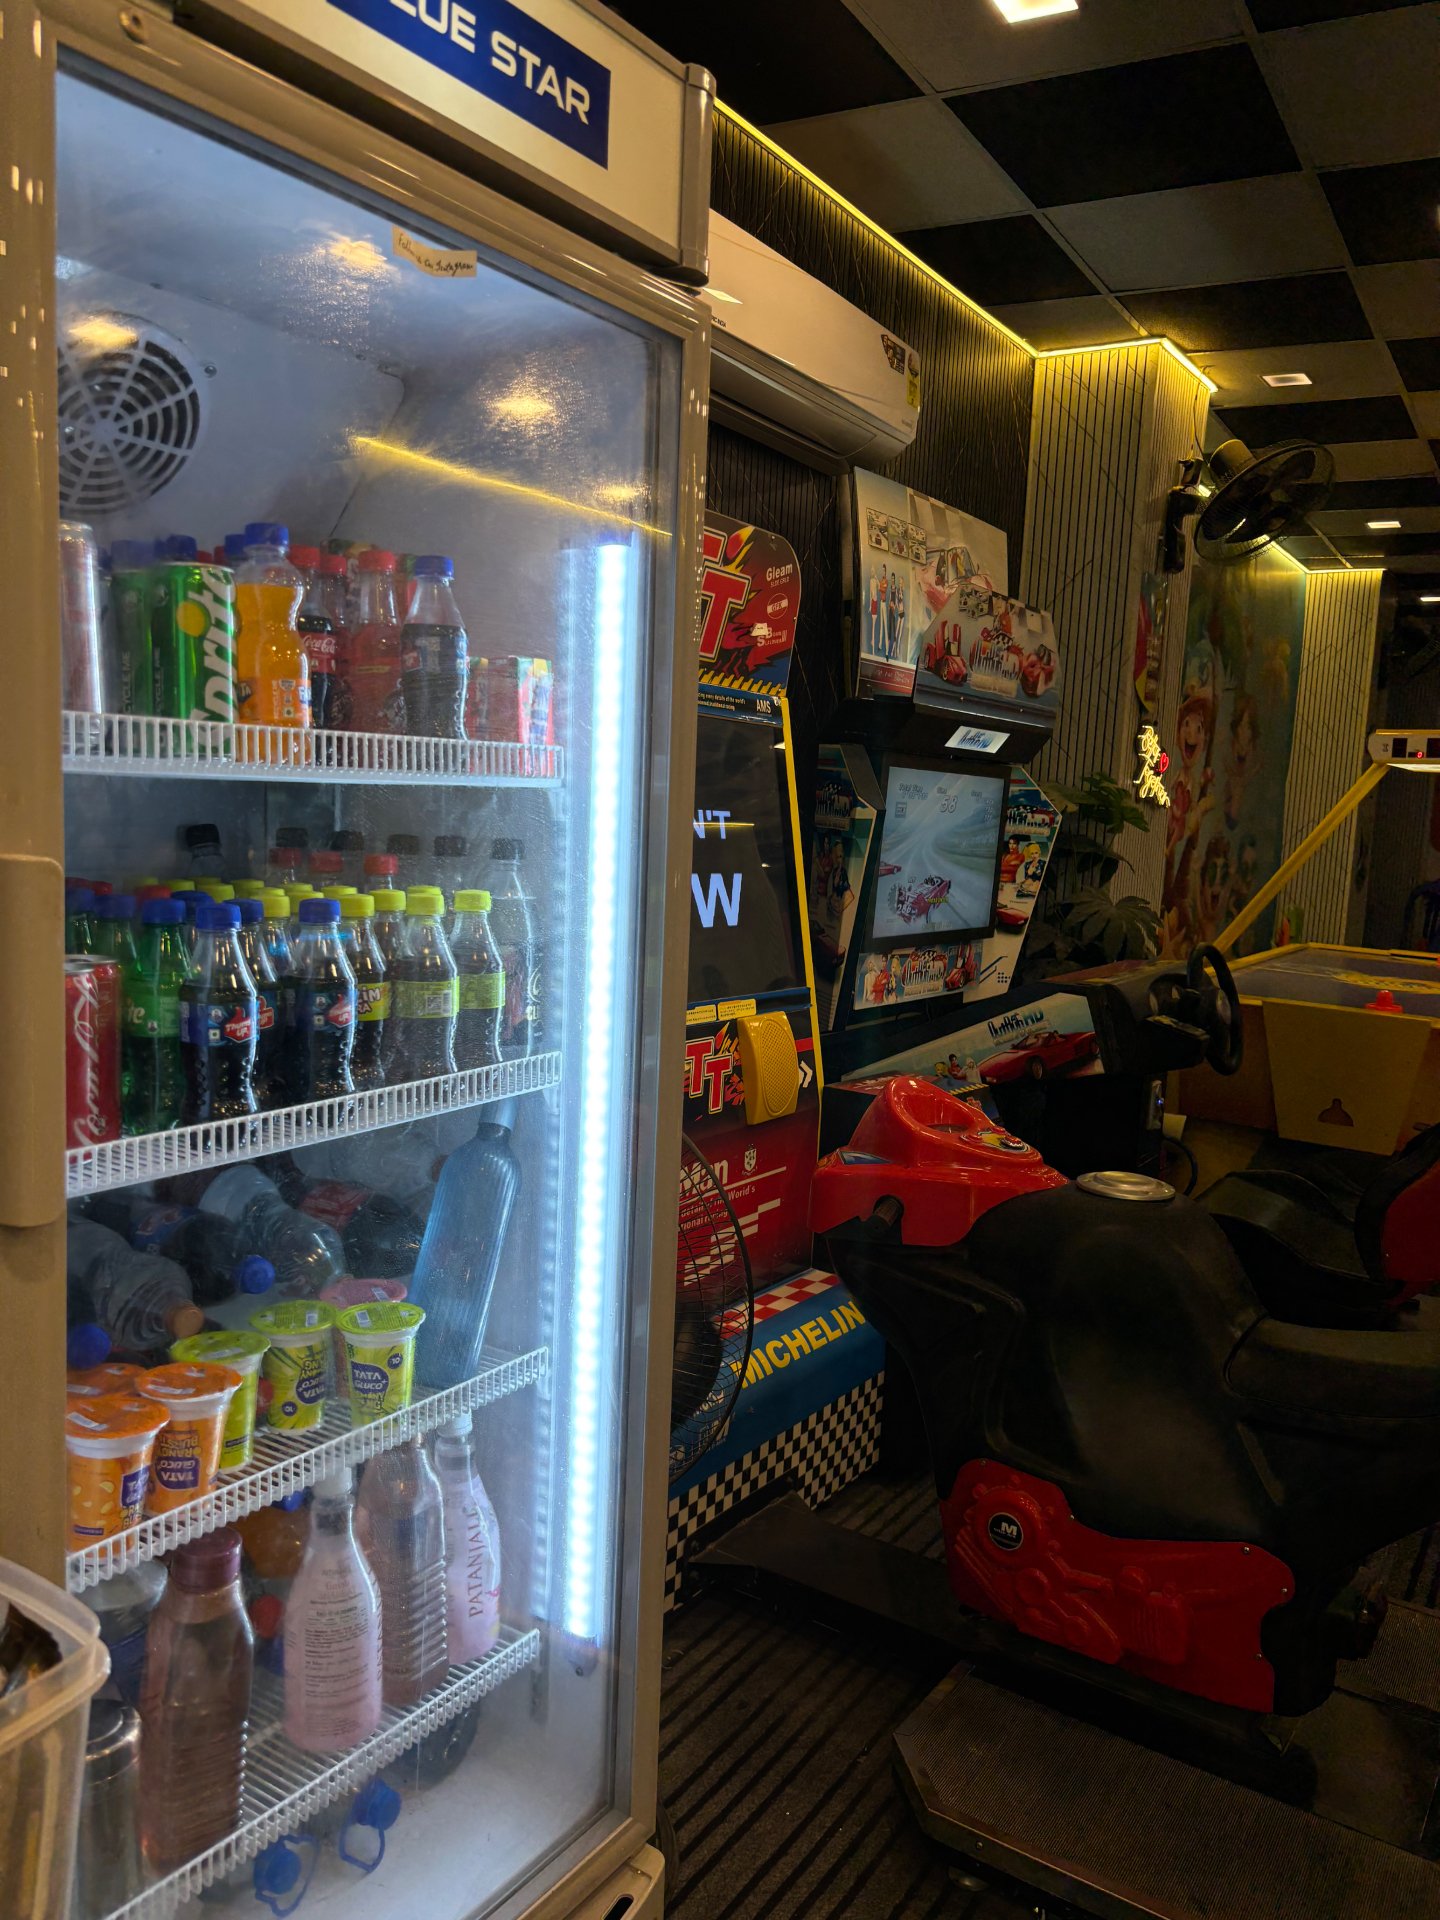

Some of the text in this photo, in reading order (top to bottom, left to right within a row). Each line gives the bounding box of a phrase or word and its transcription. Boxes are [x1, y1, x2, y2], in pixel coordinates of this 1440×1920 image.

[491, 30, 590, 125] STAR
[766, 563, 793, 582] Gleam
[189, 567, 238, 748] Sprite
[756, 698, 772, 714] AMS
[940, 795, 958, 813] 58
[730, 1300, 867, 1390] MICHELIN
[353, 1369, 382, 1380] TATA
[160, 1471, 195, 1482] TATA
[466, 1507, 488, 1618] PATANJALI
